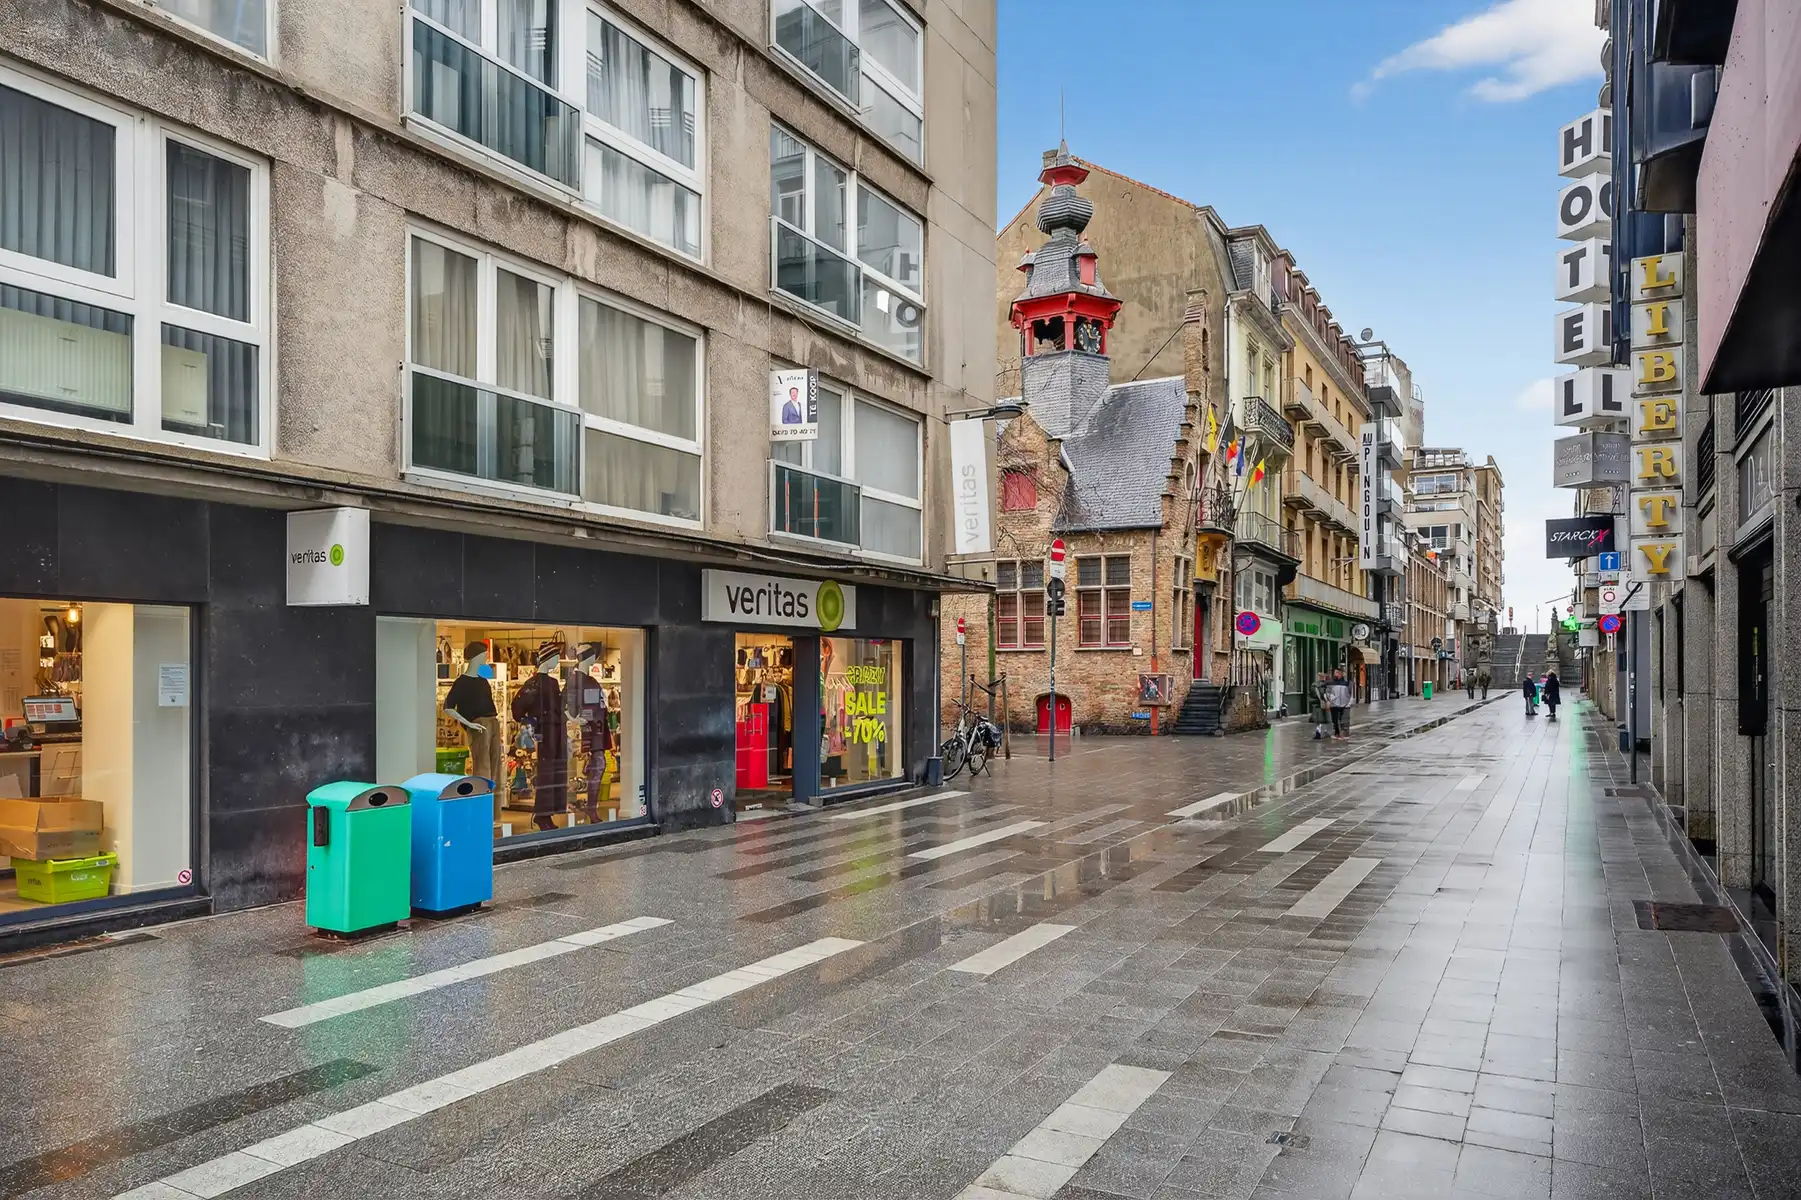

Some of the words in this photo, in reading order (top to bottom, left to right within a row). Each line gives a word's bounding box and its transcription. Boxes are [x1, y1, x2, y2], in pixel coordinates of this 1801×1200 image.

[1560, 117, 1592, 416] HOTEL
[1636, 256, 1677, 575] LIBERTY
[1362, 432, 1373, 444] AU
[960, 463, 980, 544] veritas
[291, 549, 327, 564] veritas
[726, 582, 809, 618] veritas
[845, 691, 886, 716] SALE
[844, 718, 885, 744] -70%
